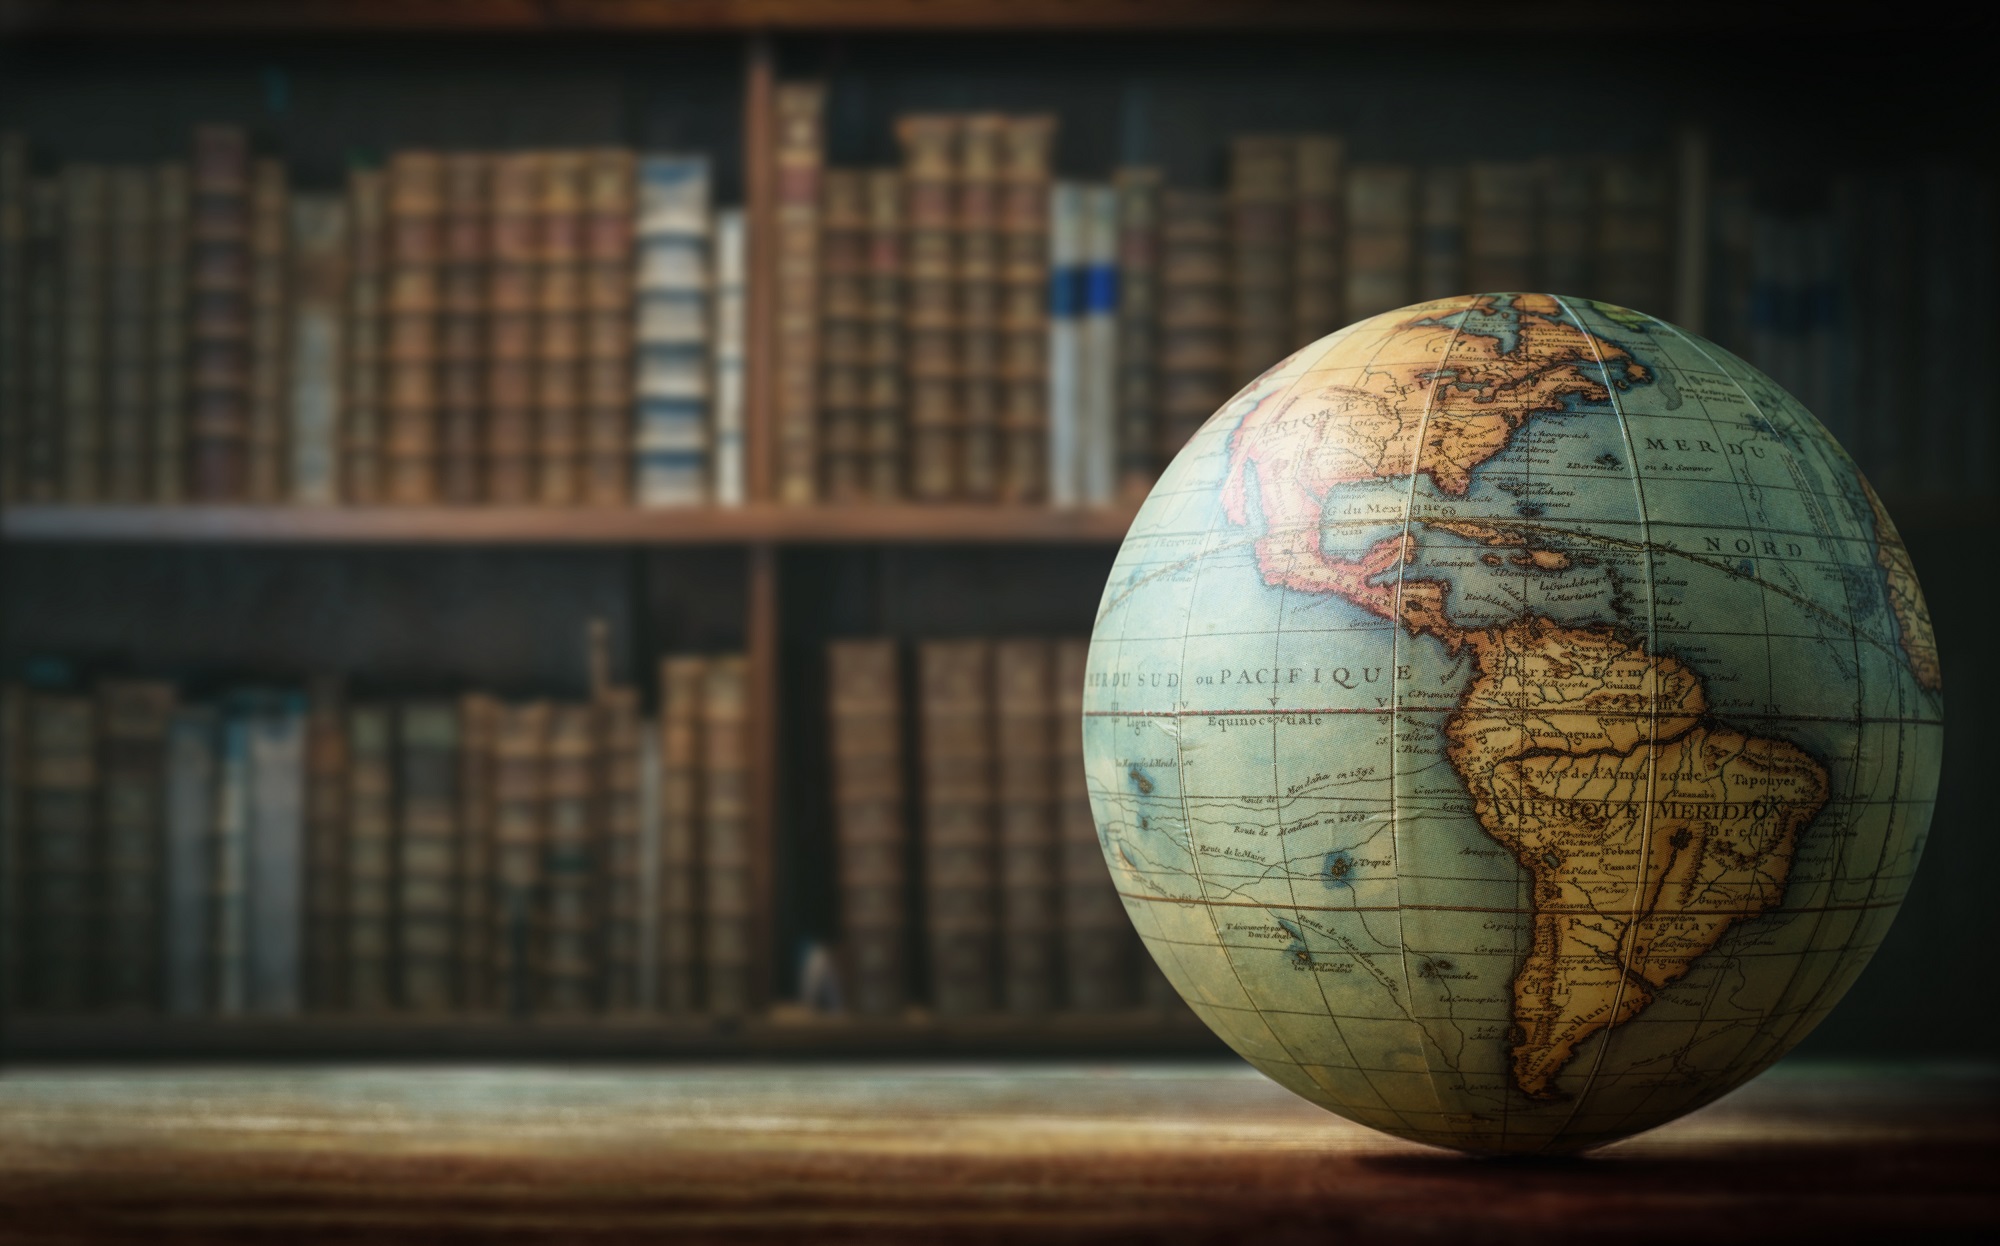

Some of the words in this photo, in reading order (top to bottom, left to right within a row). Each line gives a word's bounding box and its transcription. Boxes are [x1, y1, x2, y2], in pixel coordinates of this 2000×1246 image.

[1645, 437, 1719, 455] MER
[1727, 442, 1766, 460] DU
[1703, 536, 1803, 559] NORD
[1137, 672, 1180, 688] SUD
[1219, 665, 1413, 690] PACIFIQUE
